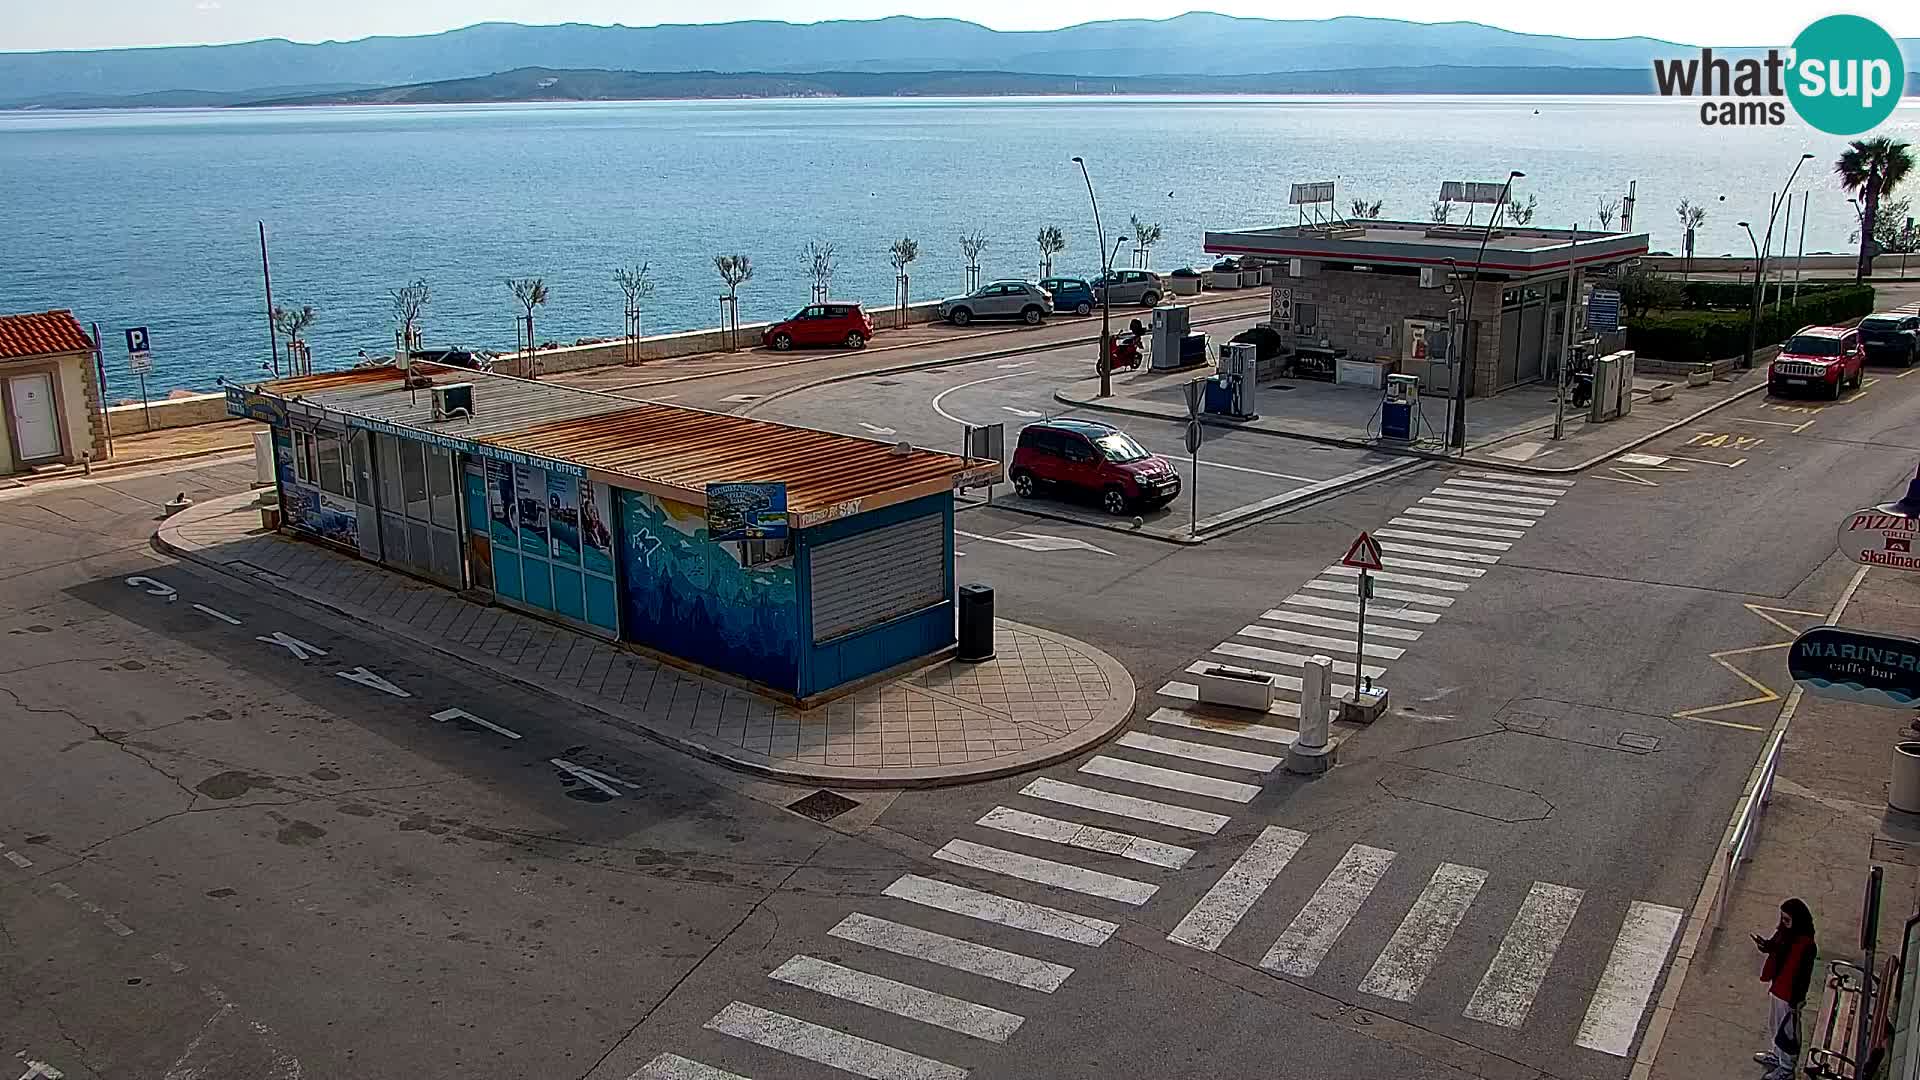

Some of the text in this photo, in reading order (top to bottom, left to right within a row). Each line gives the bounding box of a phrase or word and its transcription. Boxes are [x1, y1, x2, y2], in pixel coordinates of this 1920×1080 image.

[131, 331, 143, 349] P
[1685, 432, 1765, 450] TAXI
[396, 427, 437, 445] AUTOBUSNA
[437, 436, 469, 452] POSTAJA
[478, 445, 494, 457] BUS
[494, 449, 527, 465] STATION
[529, 456, 555, 471] TICKET
[556, 464, 583, 477] OFFICE
[1848, 515, 1920, 533] PIZZE
[1882, 531, 1914, 539] GRILL
[1828, 662, 1897, 680] caffe bar
